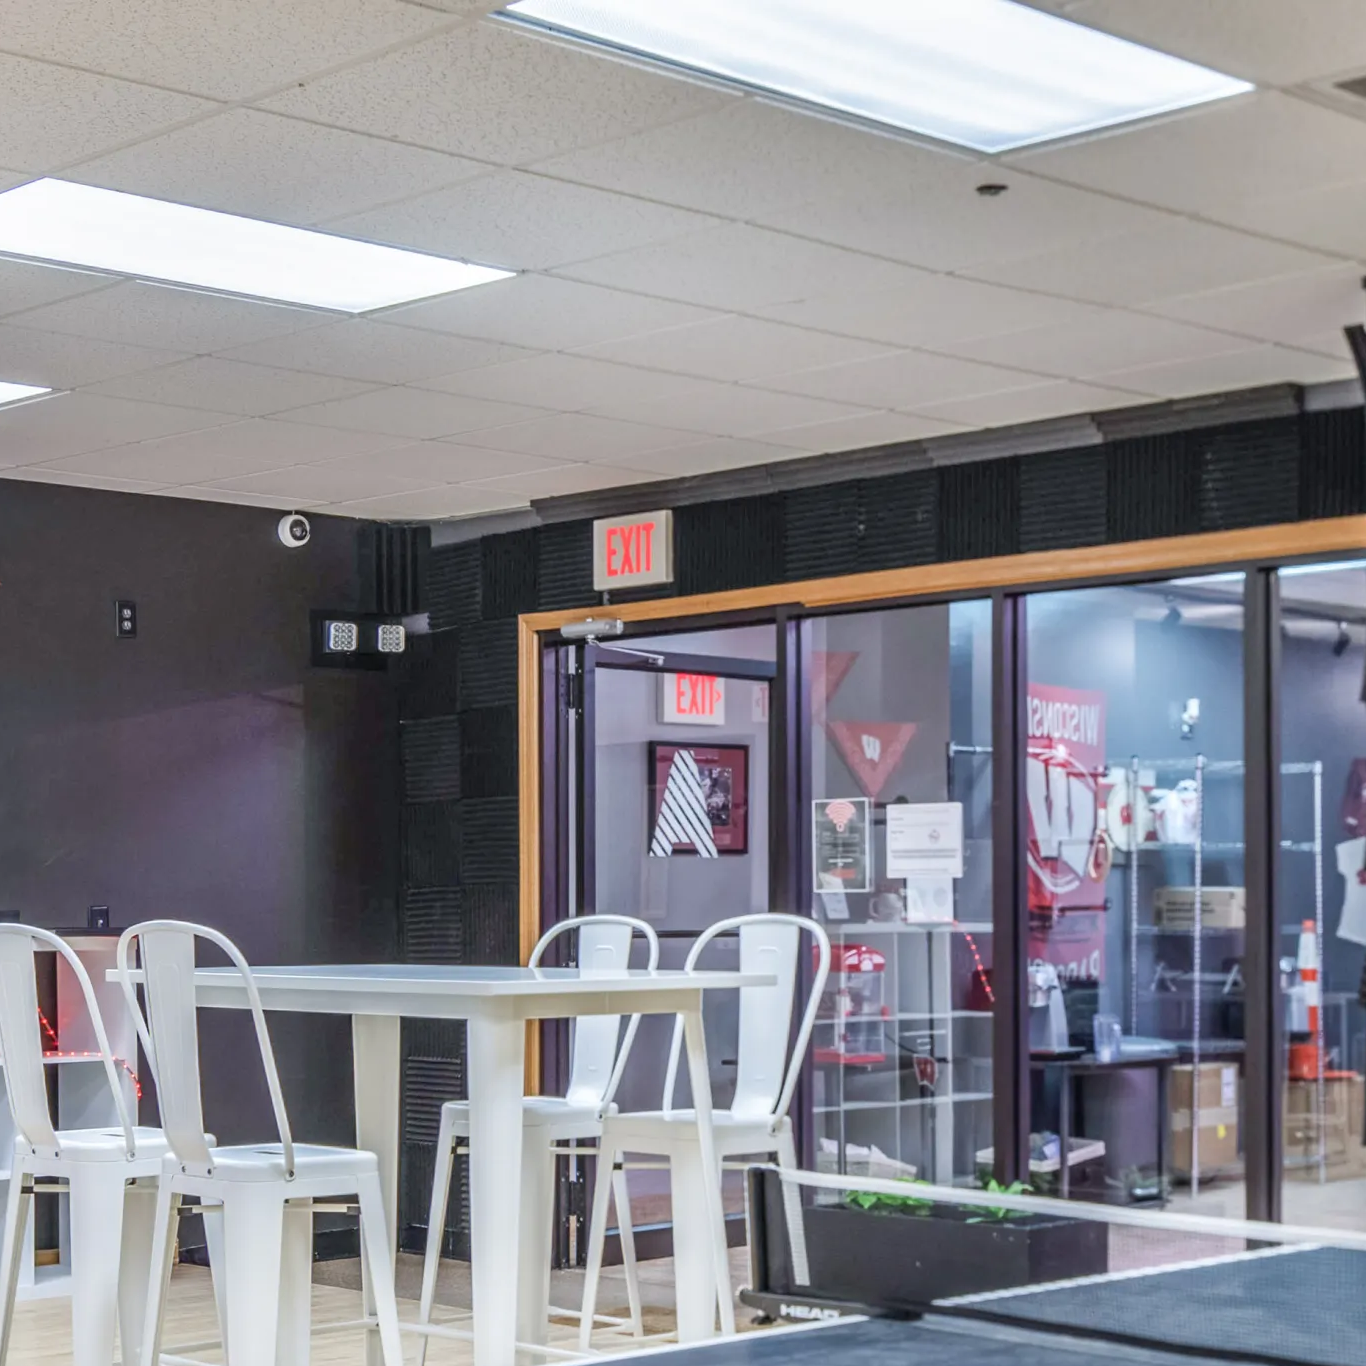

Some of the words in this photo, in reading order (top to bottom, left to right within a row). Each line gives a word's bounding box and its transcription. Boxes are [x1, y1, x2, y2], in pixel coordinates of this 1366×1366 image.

[605, 522, 655, 577] EXIT
[676, 672, 718, 716] EXIT
[780, 1303, 842, 1321] HEAD
